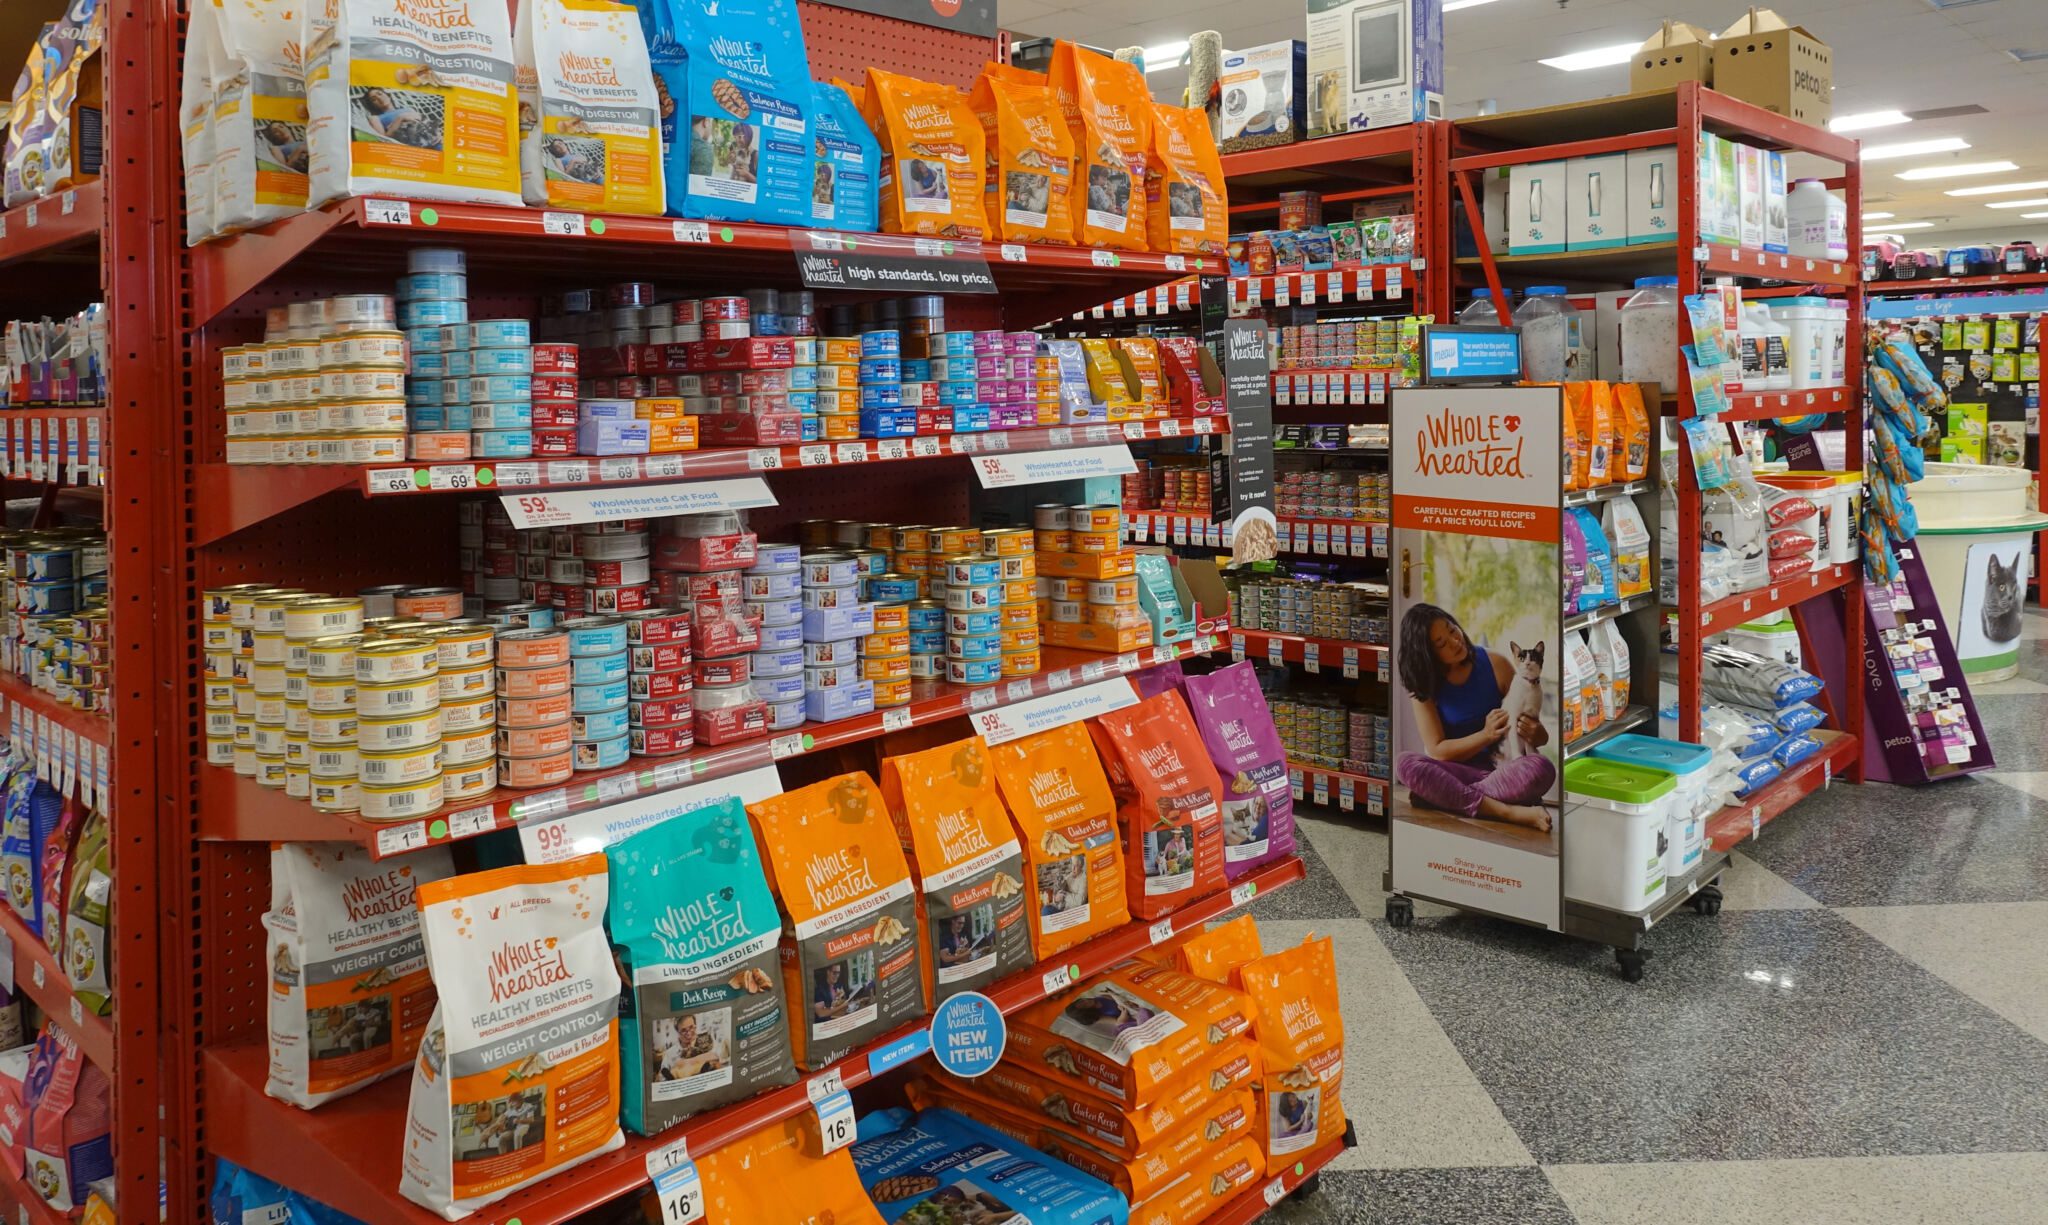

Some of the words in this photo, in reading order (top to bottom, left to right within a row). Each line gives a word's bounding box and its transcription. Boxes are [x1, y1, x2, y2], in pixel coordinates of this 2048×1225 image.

[372, 16, 429, 39] HEALTHY
[432, 29, 494, 45] BENEFITS
[385, 45, 422, 60] EASY
[423, 53, 494, 72] DIGESTION
[711, 36, 755, 58] WHOLE
[561, 51, 604, 70] WHOLE
[709, 44, 772, 78] hearted
[559, 58, 623, 87] hearted
[1794, 69, 1820, 95] petco
[594, 88, 639, 97] BENEFITS
[749, 92, 777, 109] Salmon
[777, 99, 799, 115] Recipe
[562, 104, 586, 117] EASY
[587, 110, 640, 120] DIGESTION
[903, 112, 953, 130] hearted
[905, 104, 939, 120] WHOLE
[936, 131, 954, 139] FREE
[802, 261, 846, 284] hearted
[803, 254, 833, 271] WHOLE
[848, 266, 876, 281] high
[878, 269, 938, 282] standards.
[940, 271, 960, 283] low
[962, 273, 993, 285] price.
[1915, 303, 1931, 311] cat
[1232, 328, 1258, 347] WHOLE
[1230, 338, 1266, 361] hearted
[1427, 408, 1501, 448] WHOLE
[1414, 430, 1525, 479] hearted
[1787, 440, 1809, 455] Comfort
[1790, 447, 1812, 461] zone
[1086, 457, 1103, 466] Food
[521, 496, 550, 514] 59¢
[590, 495, 669, 509] WholeHearted
[671, 494, 690, 502] Cat
[692, 491, 719, 500] Food
[1240, 493, 1248, 501] try
[1254, 490, 1267, 499] now!
[1413, 506, 1459, 516] CAREFULLY
[1460, 508, 1499, 518] CRAFTED
[1500, 510, 1536, 520] RECIPES
[1422, 515, 1433, 524] AT
[1435, 516, 1442, 524] A
[1443, 516, 1467, 526] PRICE
[1468, 518, 1499, 528] YOU'LL
[1500, 519, 1526, 529] LOVE.
[1864, 651, 1882, 692] Love.
[1024, 703, 1073, 722] WholeHearted
[1073, 700, 1085, 709] Cat
[1085, 695, 1103, 705] Food
[1884, 735, 1912, 749] petco
[1246, 752, 1259, 761] FREE
[1028, 768, 1061, 794] WHOLE
[1028, 776, 1081, 809] hearted
[605, 808, 684, 833] WholeHearted
[686, 801, 704, 814] Cat
[1044, 810, 1067, 824] GRAIN
[1067, 802, 1086, 815] FREE
[537, 823, 567, 850] 99¢
[936, 808, 971, 842] WHOLE
[1067, 823, 1091, 838] Chicken
[1090, 818, 1108, 832] Recipe
[807, 849, 853, 887] WHOLE
[965, 849, 1005, 874] INGREDIENT
[1454, 858, 1475, 869] Share
[1477, 863, 1493, 873] your
[343, 870, 401, 902] WHOLE
[805, 857, 878, 912] hearted
[1427, 861, 1523, 888] #WHOLEHEARTEDPETS
[1442, 875, 1476, 887] moments
[1478, 882, 1494, 891] with
[510, 901, 521, 909] ALL
[521, 897, 552, 905] BREEDS
[815, 911, 844, 931] LIMITED
[844, 891, 892, 920] INGREDIENT
[655, 892, 723, 941] WHOLE
[328, 919, 384, 944] HEALTHY
[652, 902, 752, 962] hearted
[829, 937, 852, 955] Chicken
[852, 931, 873, 948] Recipe
[331, 951, 384, 975] WEIGHT
[494, 938, 546, 979] WHOLE
[662, 963, 701, 979] LIMITED
[702, 940, 764, 970] INGREDIENT
[488, 947, 575, 1005] hearted
[471, 1000, 531, 1030] HEALTHY
[535, 978, 594, 1007] BENEFITS
[682, 994, 701, 1007] Duck
[702, 987, 728, 1004] Recipe
[479, 1021, 516, 1038] SPECIALIZED
[516, 1013, 537, 1027] GRAIN
[536, 1009, 551, 1020] FREE
[550, 1003, 569, 1015] FOOD
[568, 999, 579, 1009] FOR
[579, 994, 594, 1005] CATS
[947, 1009, 987, 1030] hearted
[950, 1001, 977, 1019] WHOLE
[480, 1036, 537, 1066] WEIGHT
[539, 1011, 604, 1043] CONTROL
[547, 1045, 573, 1063] Chicken
[592, 1031, 609, 1050] Recipe
[948, 1029, 988, 1047] NEW
[1309, 1032, 1326, 1047] FREE
[882, 1051, 898, 1063] NEW
[898, 1043, 916, 1057] ITEM!
[949, 1046, 994, 1064] ITEM!
[1077, 1053, 1099, 1075] Chicken
[1099, 1063, 1119, 1083] Recipe
[1072, 1101, 1097, 1121] Chicken
[1097, 1112, 1119, 1130] Recipe
[879, 1153, 914, 1176] GRAIN
[916, 1140, 948, 1161] FREE
[920, 1153, 957, 1174] Salmon
[956, 1145, 985, 1163] Recipe
